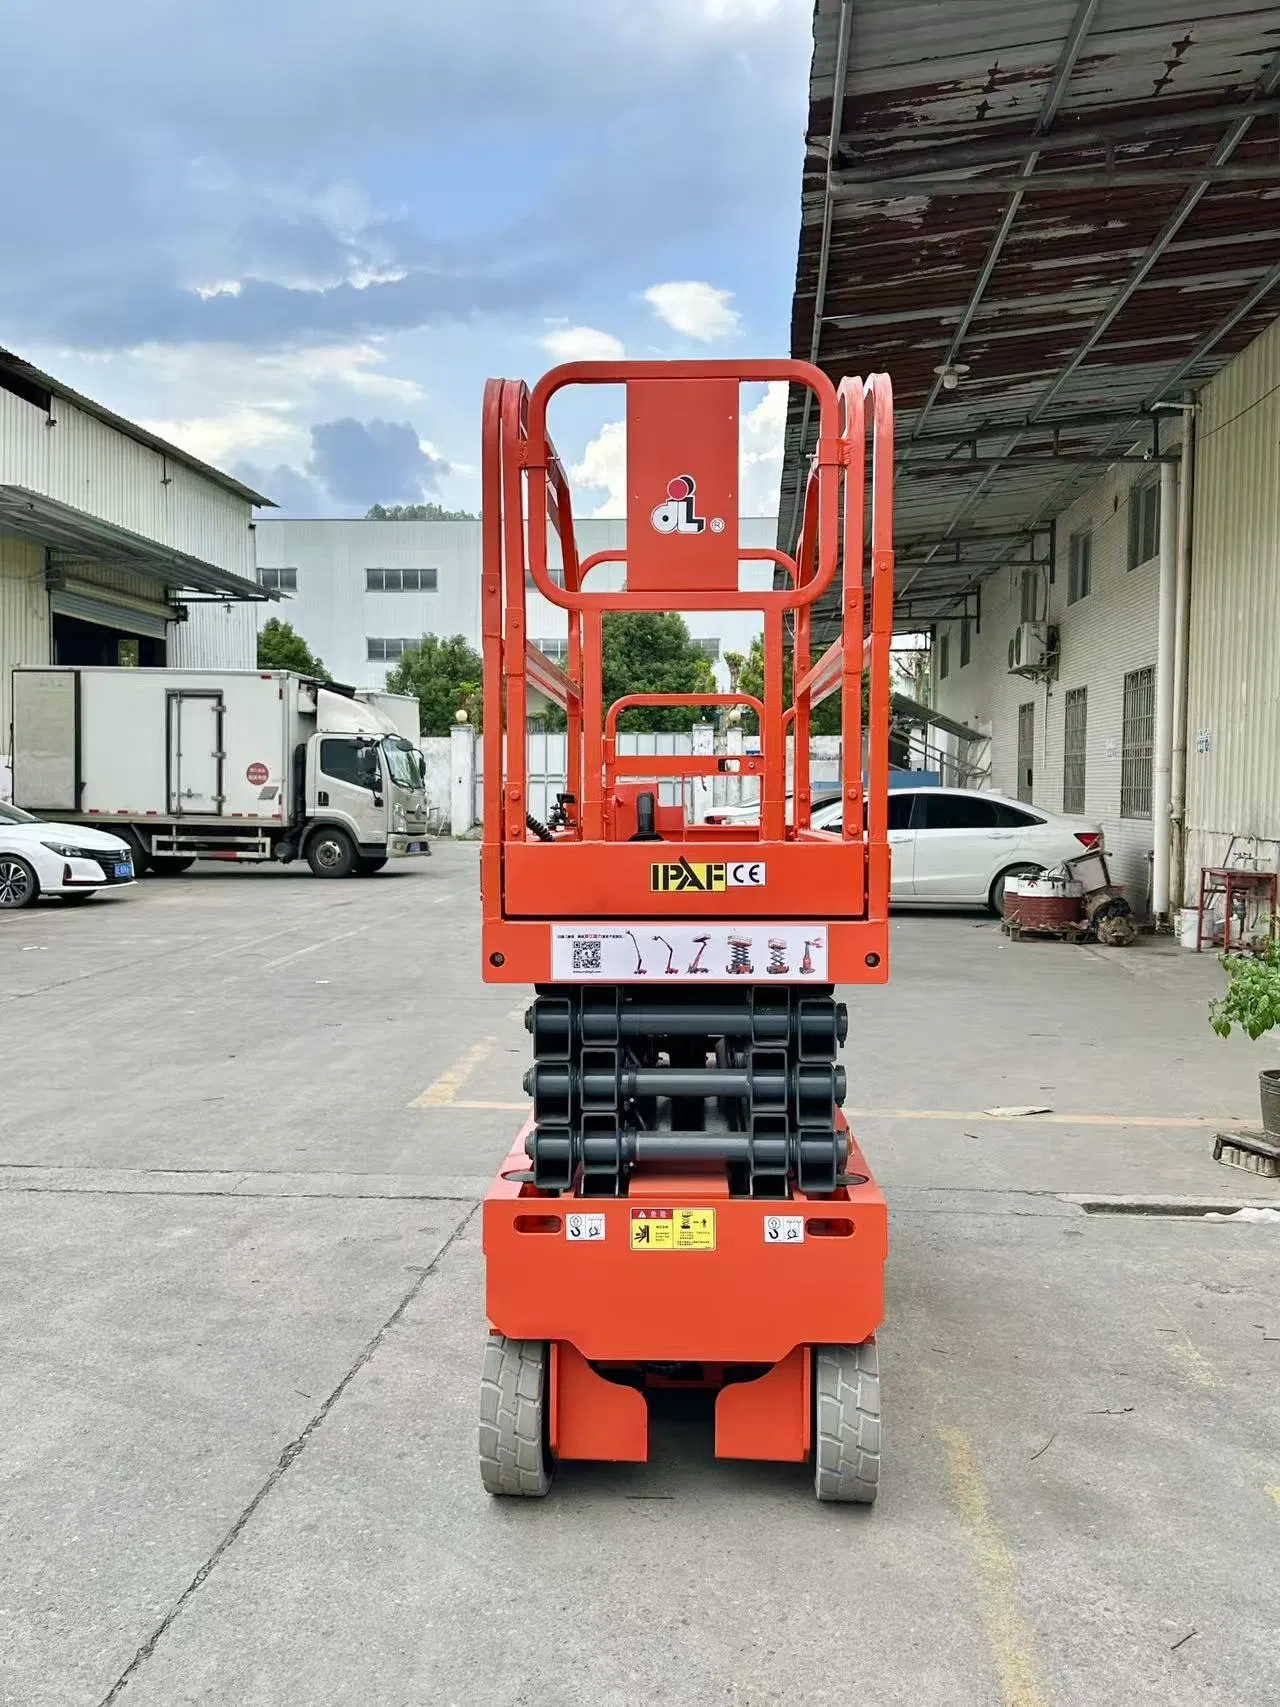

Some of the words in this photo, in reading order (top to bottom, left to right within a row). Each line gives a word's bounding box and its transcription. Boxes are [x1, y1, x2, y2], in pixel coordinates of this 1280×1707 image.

[652, 856, 724, 890] IPAF
[733, 864, 760, 883] CE
[650, 1210, 667, 1218] 危险
